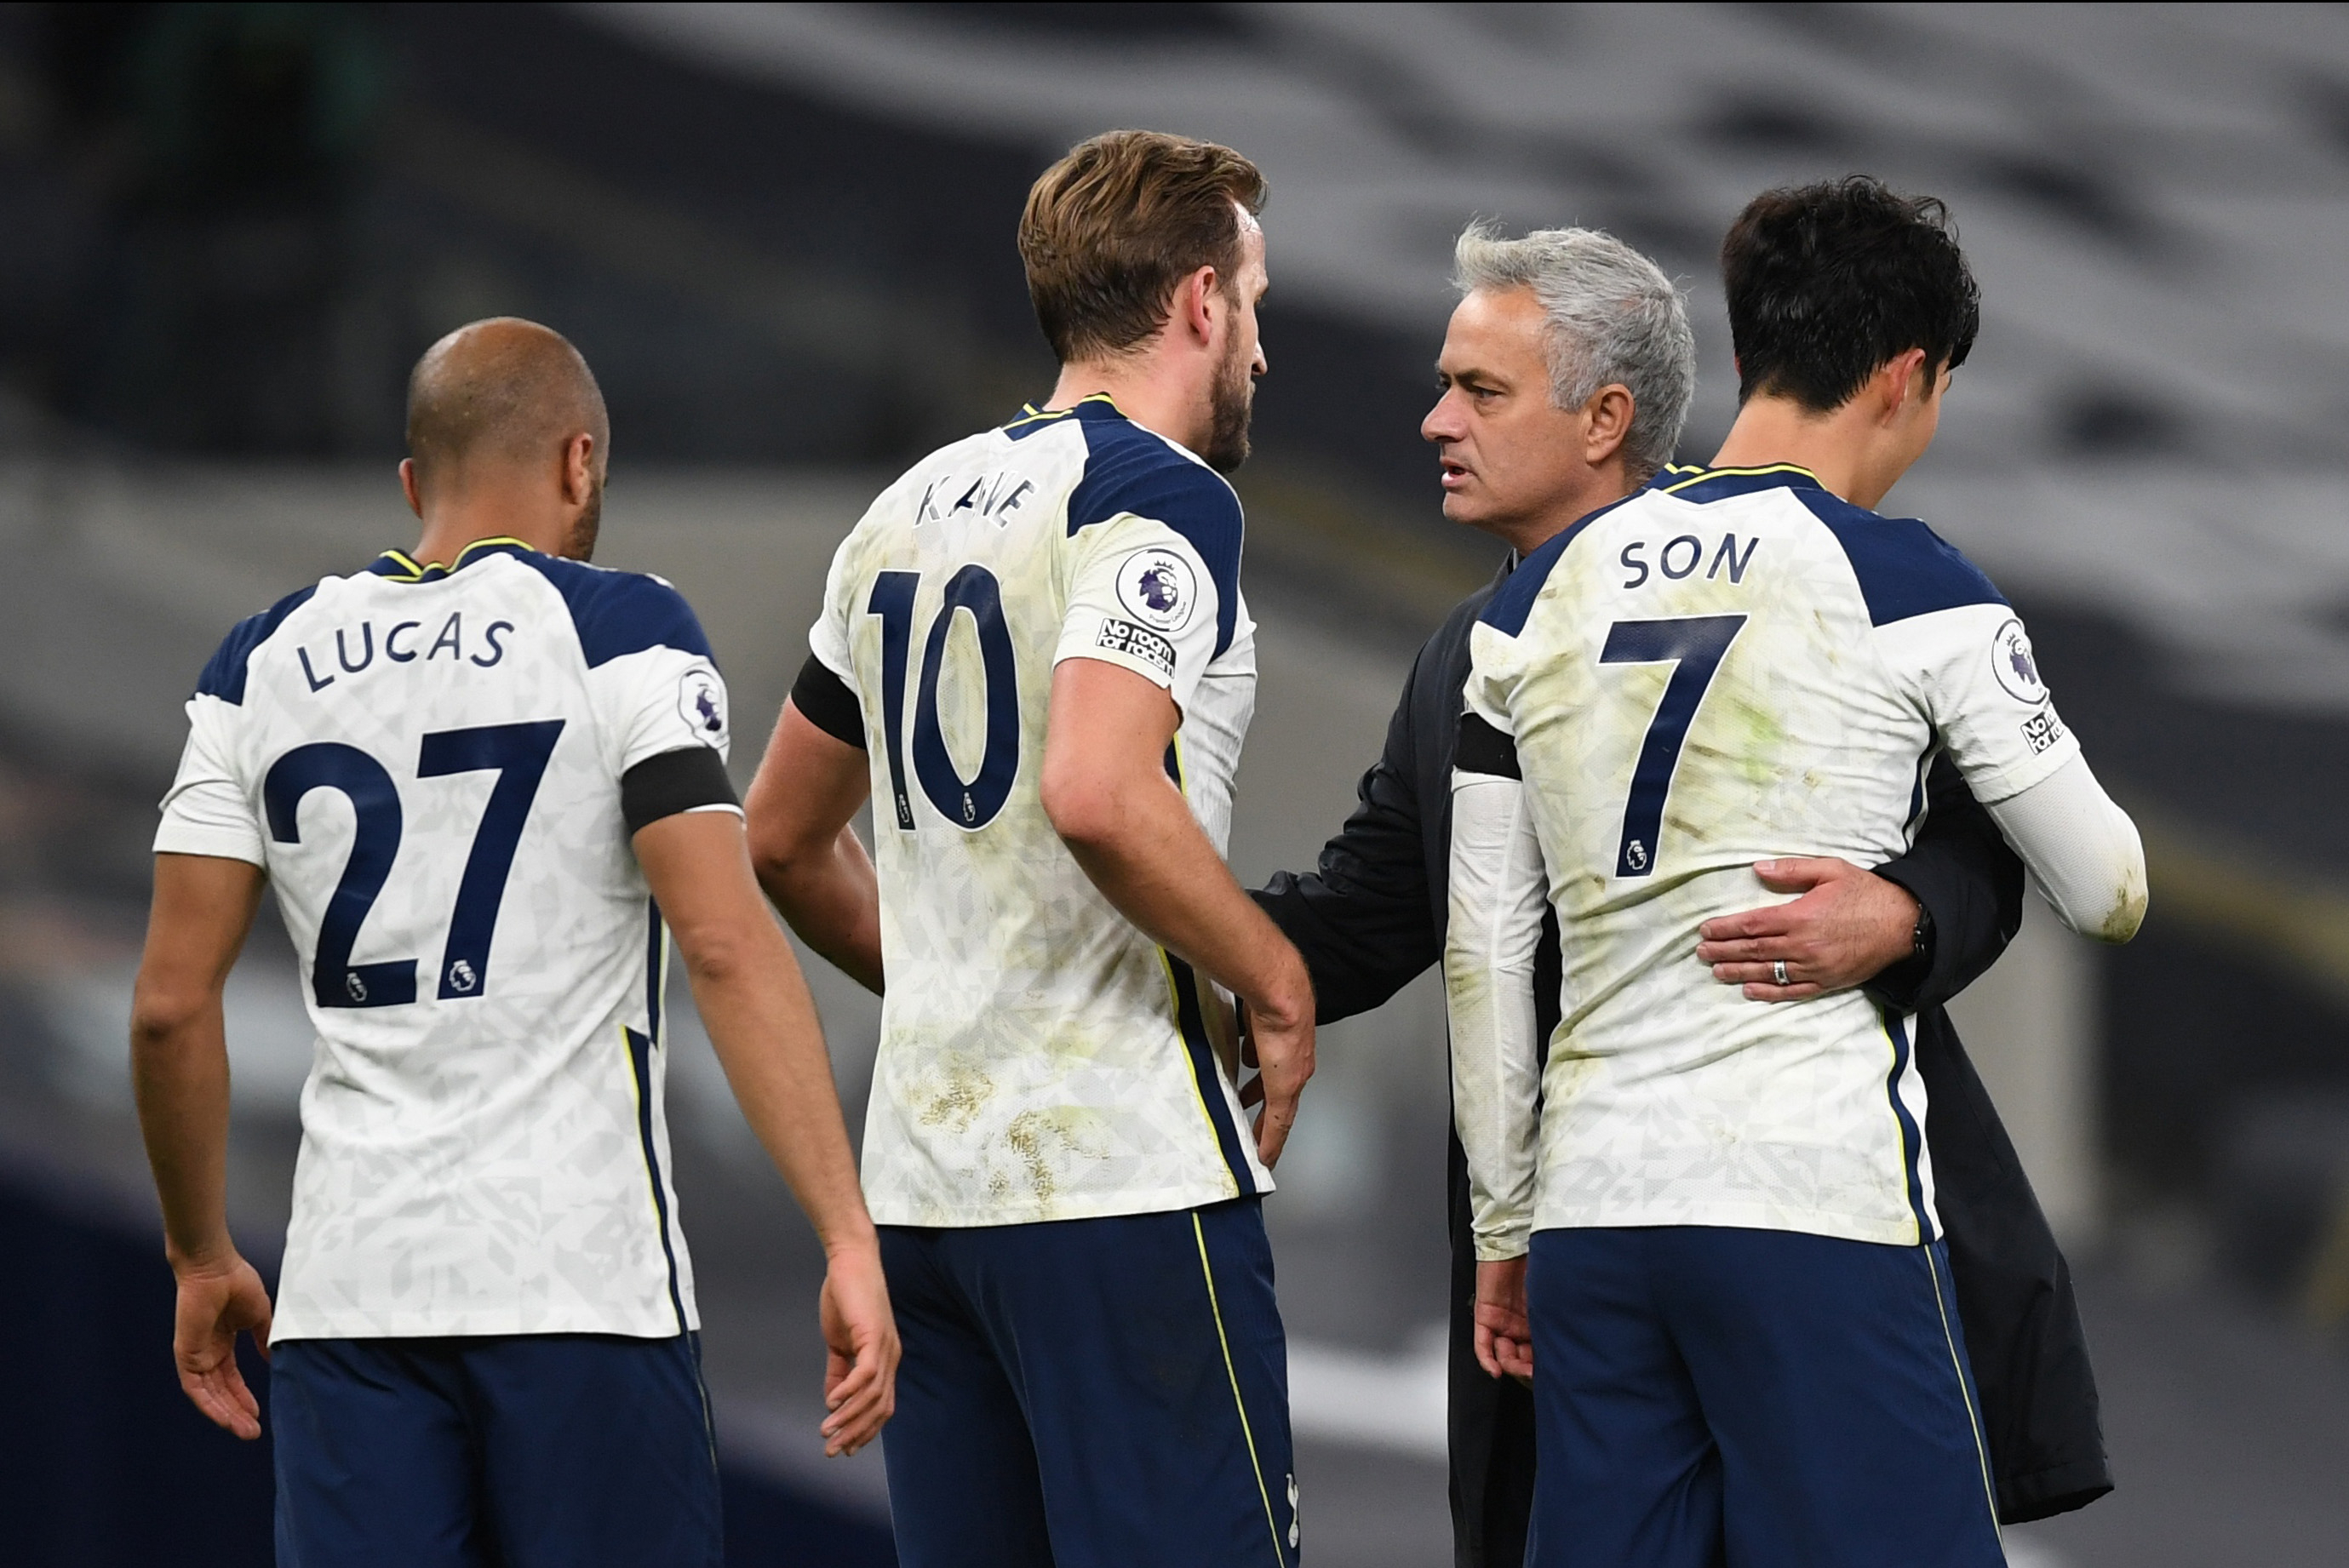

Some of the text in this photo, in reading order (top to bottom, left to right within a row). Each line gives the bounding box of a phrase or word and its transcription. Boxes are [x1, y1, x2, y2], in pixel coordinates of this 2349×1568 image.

[1620, 532, 1759, 588] SON
[296, 611, 515, 693] LUCAS
[1097, 632, 1175, 679] for racism
[1103, 619, 1172, 661] No room
[867, 564, 1019, 832] 10
[2021, 718, 2046, 741] No
[1598, 614, 1750, 878] 7
[263, 718, 565, 1008] 27
